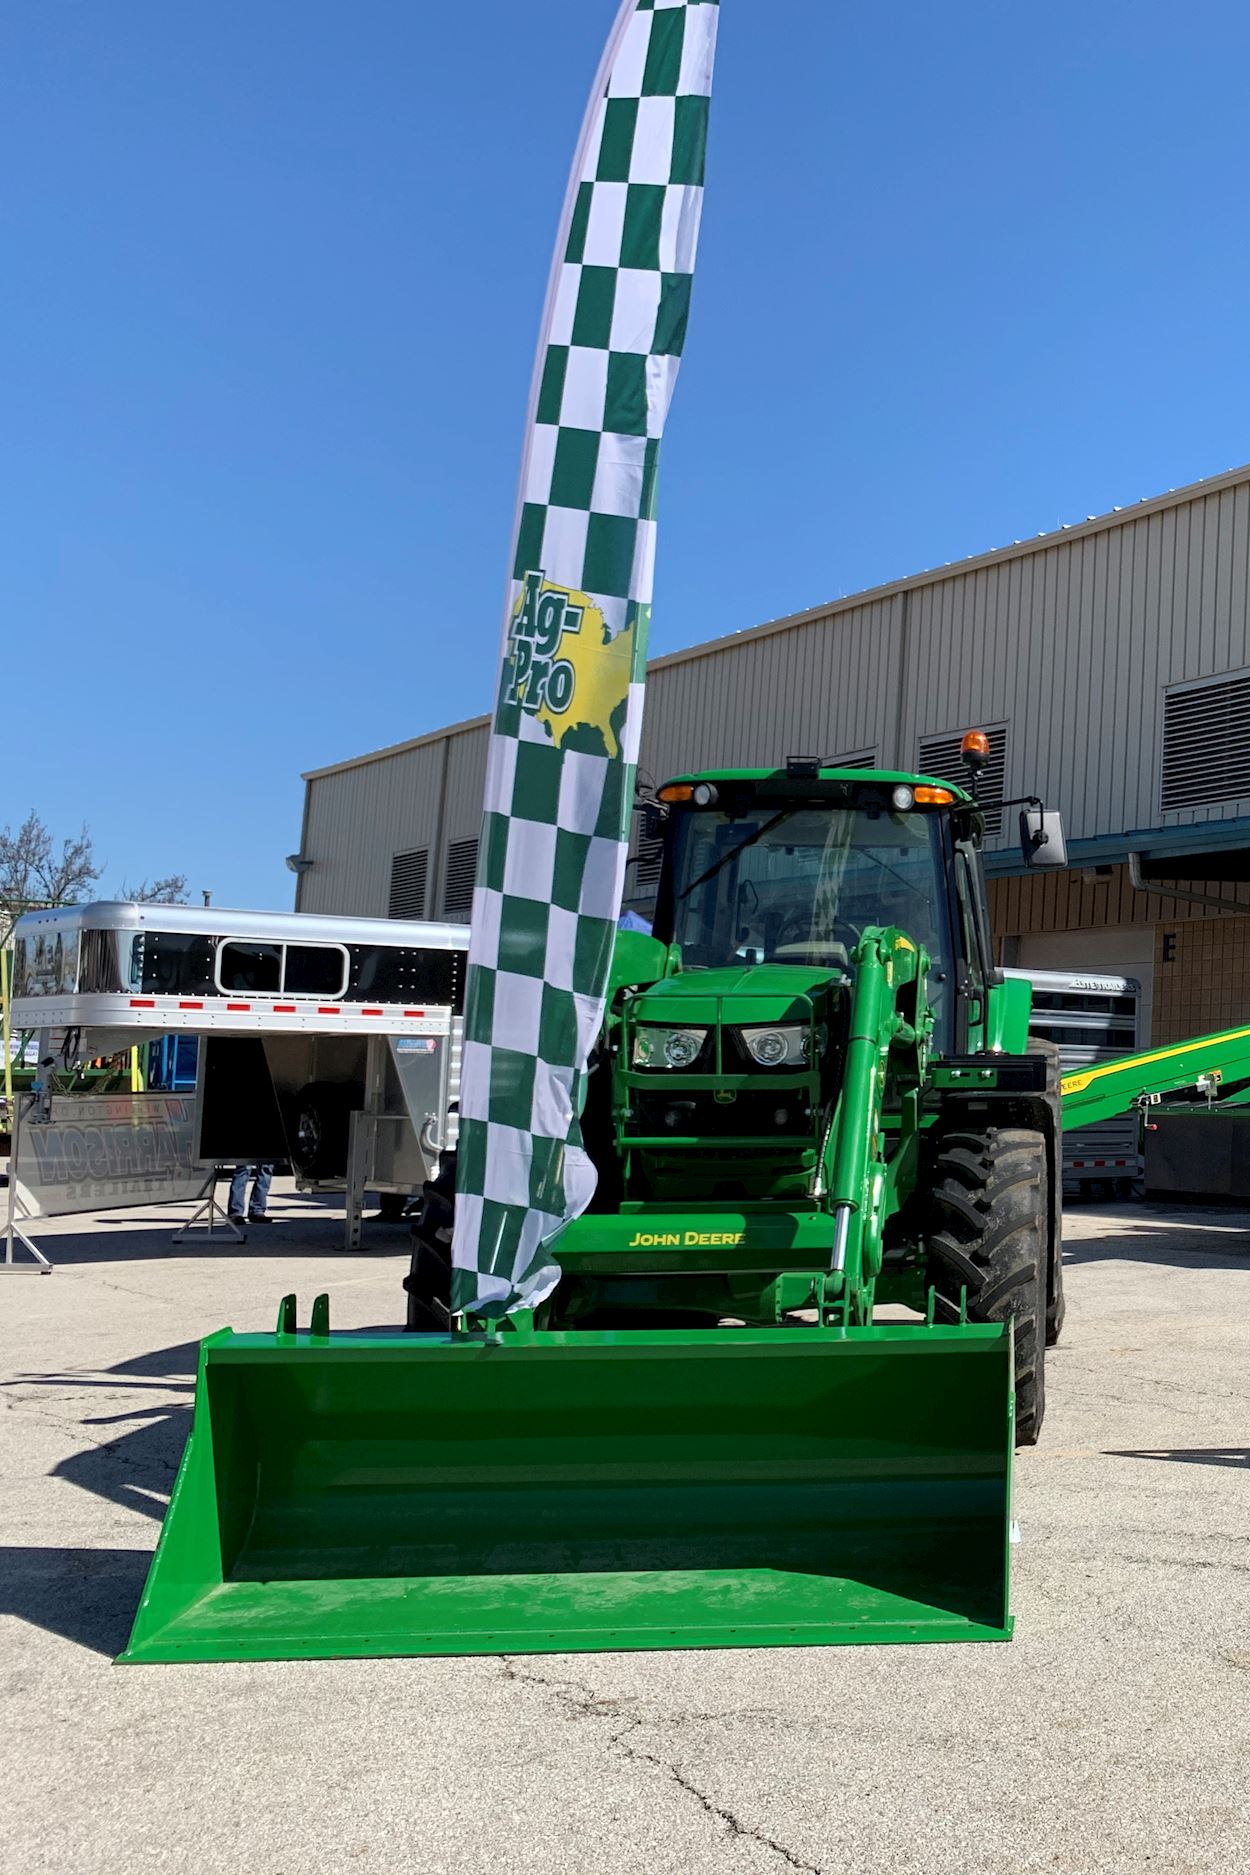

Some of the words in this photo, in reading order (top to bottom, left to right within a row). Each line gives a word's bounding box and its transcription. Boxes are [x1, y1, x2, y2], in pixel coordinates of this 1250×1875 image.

[508, 570, 584, 659] Ag-
[503, 638, 576, 715] Pro
[1163, 933, 1176, 962] E
[1060, 1080, 1083, 1090] EERE
[629, 1232, 680, 1247] JOHN
[684, 1231, 746, 1246] DEERE
